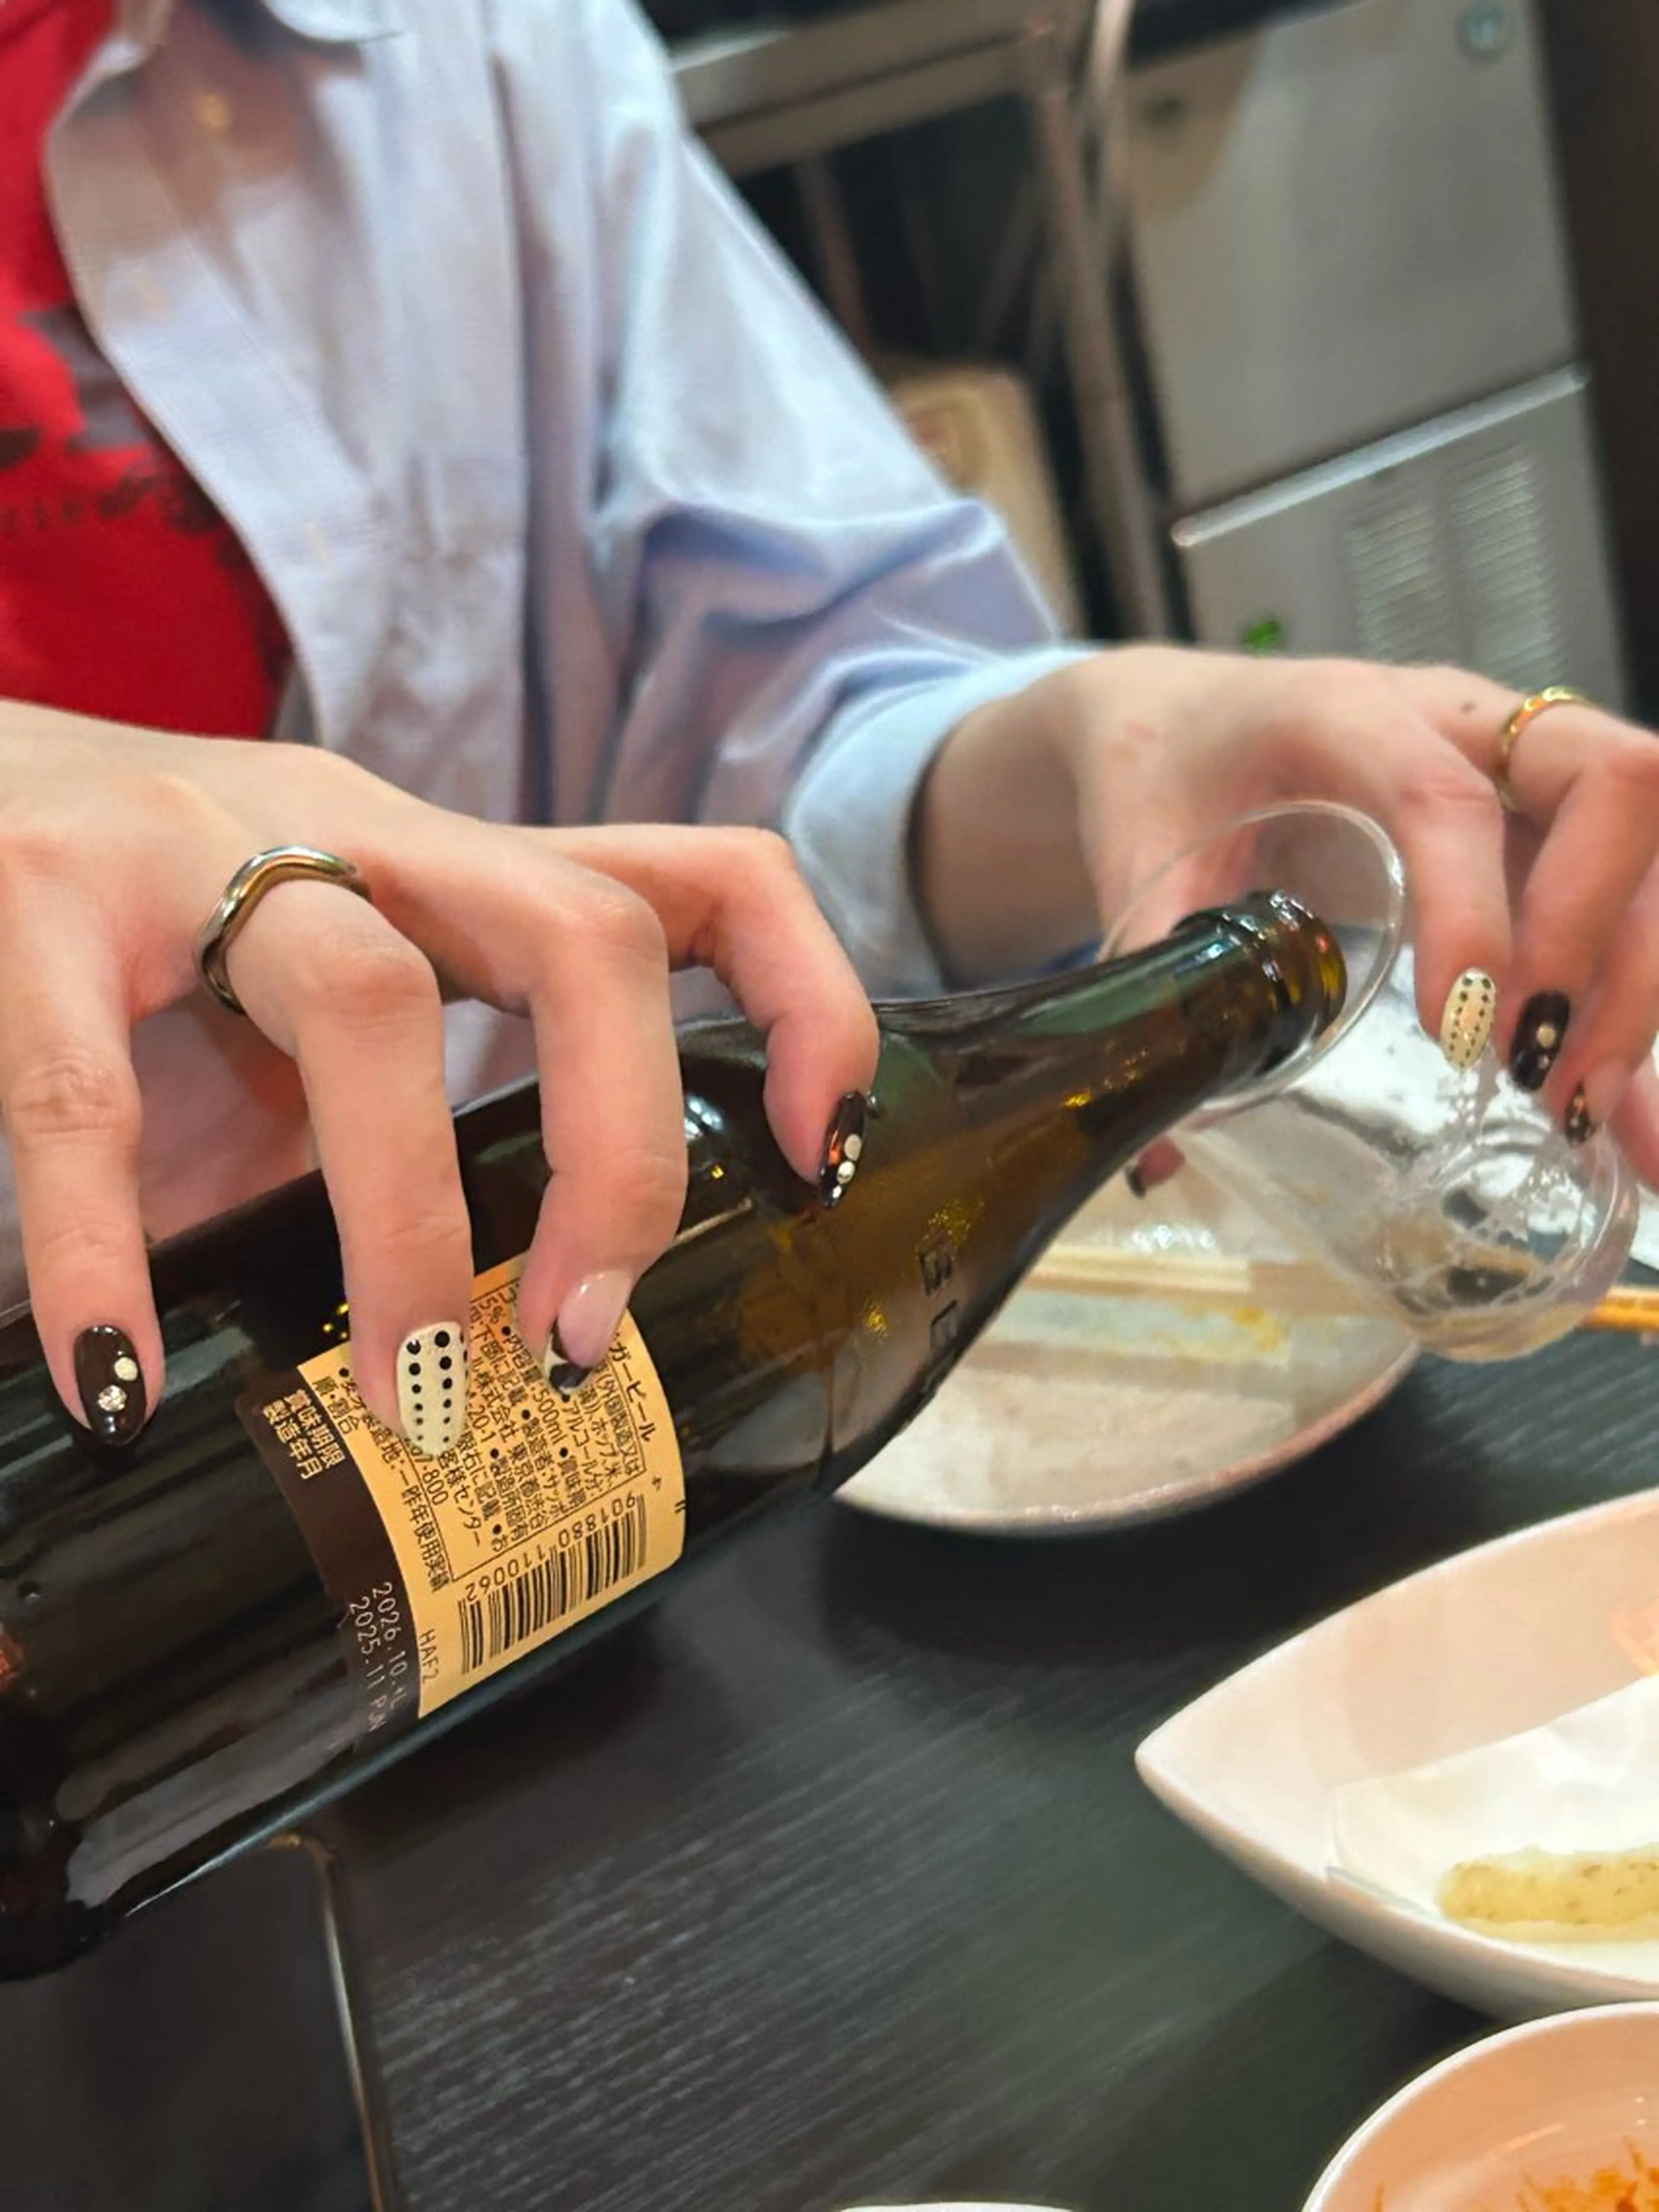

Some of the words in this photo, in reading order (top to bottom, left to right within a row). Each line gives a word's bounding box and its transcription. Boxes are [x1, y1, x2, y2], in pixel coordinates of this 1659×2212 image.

[480, 1297, 505, 1324] 5%
[610, 1332, 655, 1441] ガービール
[263, 1399, 323, 1480] 製造年月
[284, 1389, 346, 1469] 賞味期限
[490, 1456, 528, 1541] 製造所固有
[509, 1442, 550, 1530] 東京都渋谷
[350, 1596, 386, 1689] 2025.11
[419, 1628, 440, 1684] HAF2
